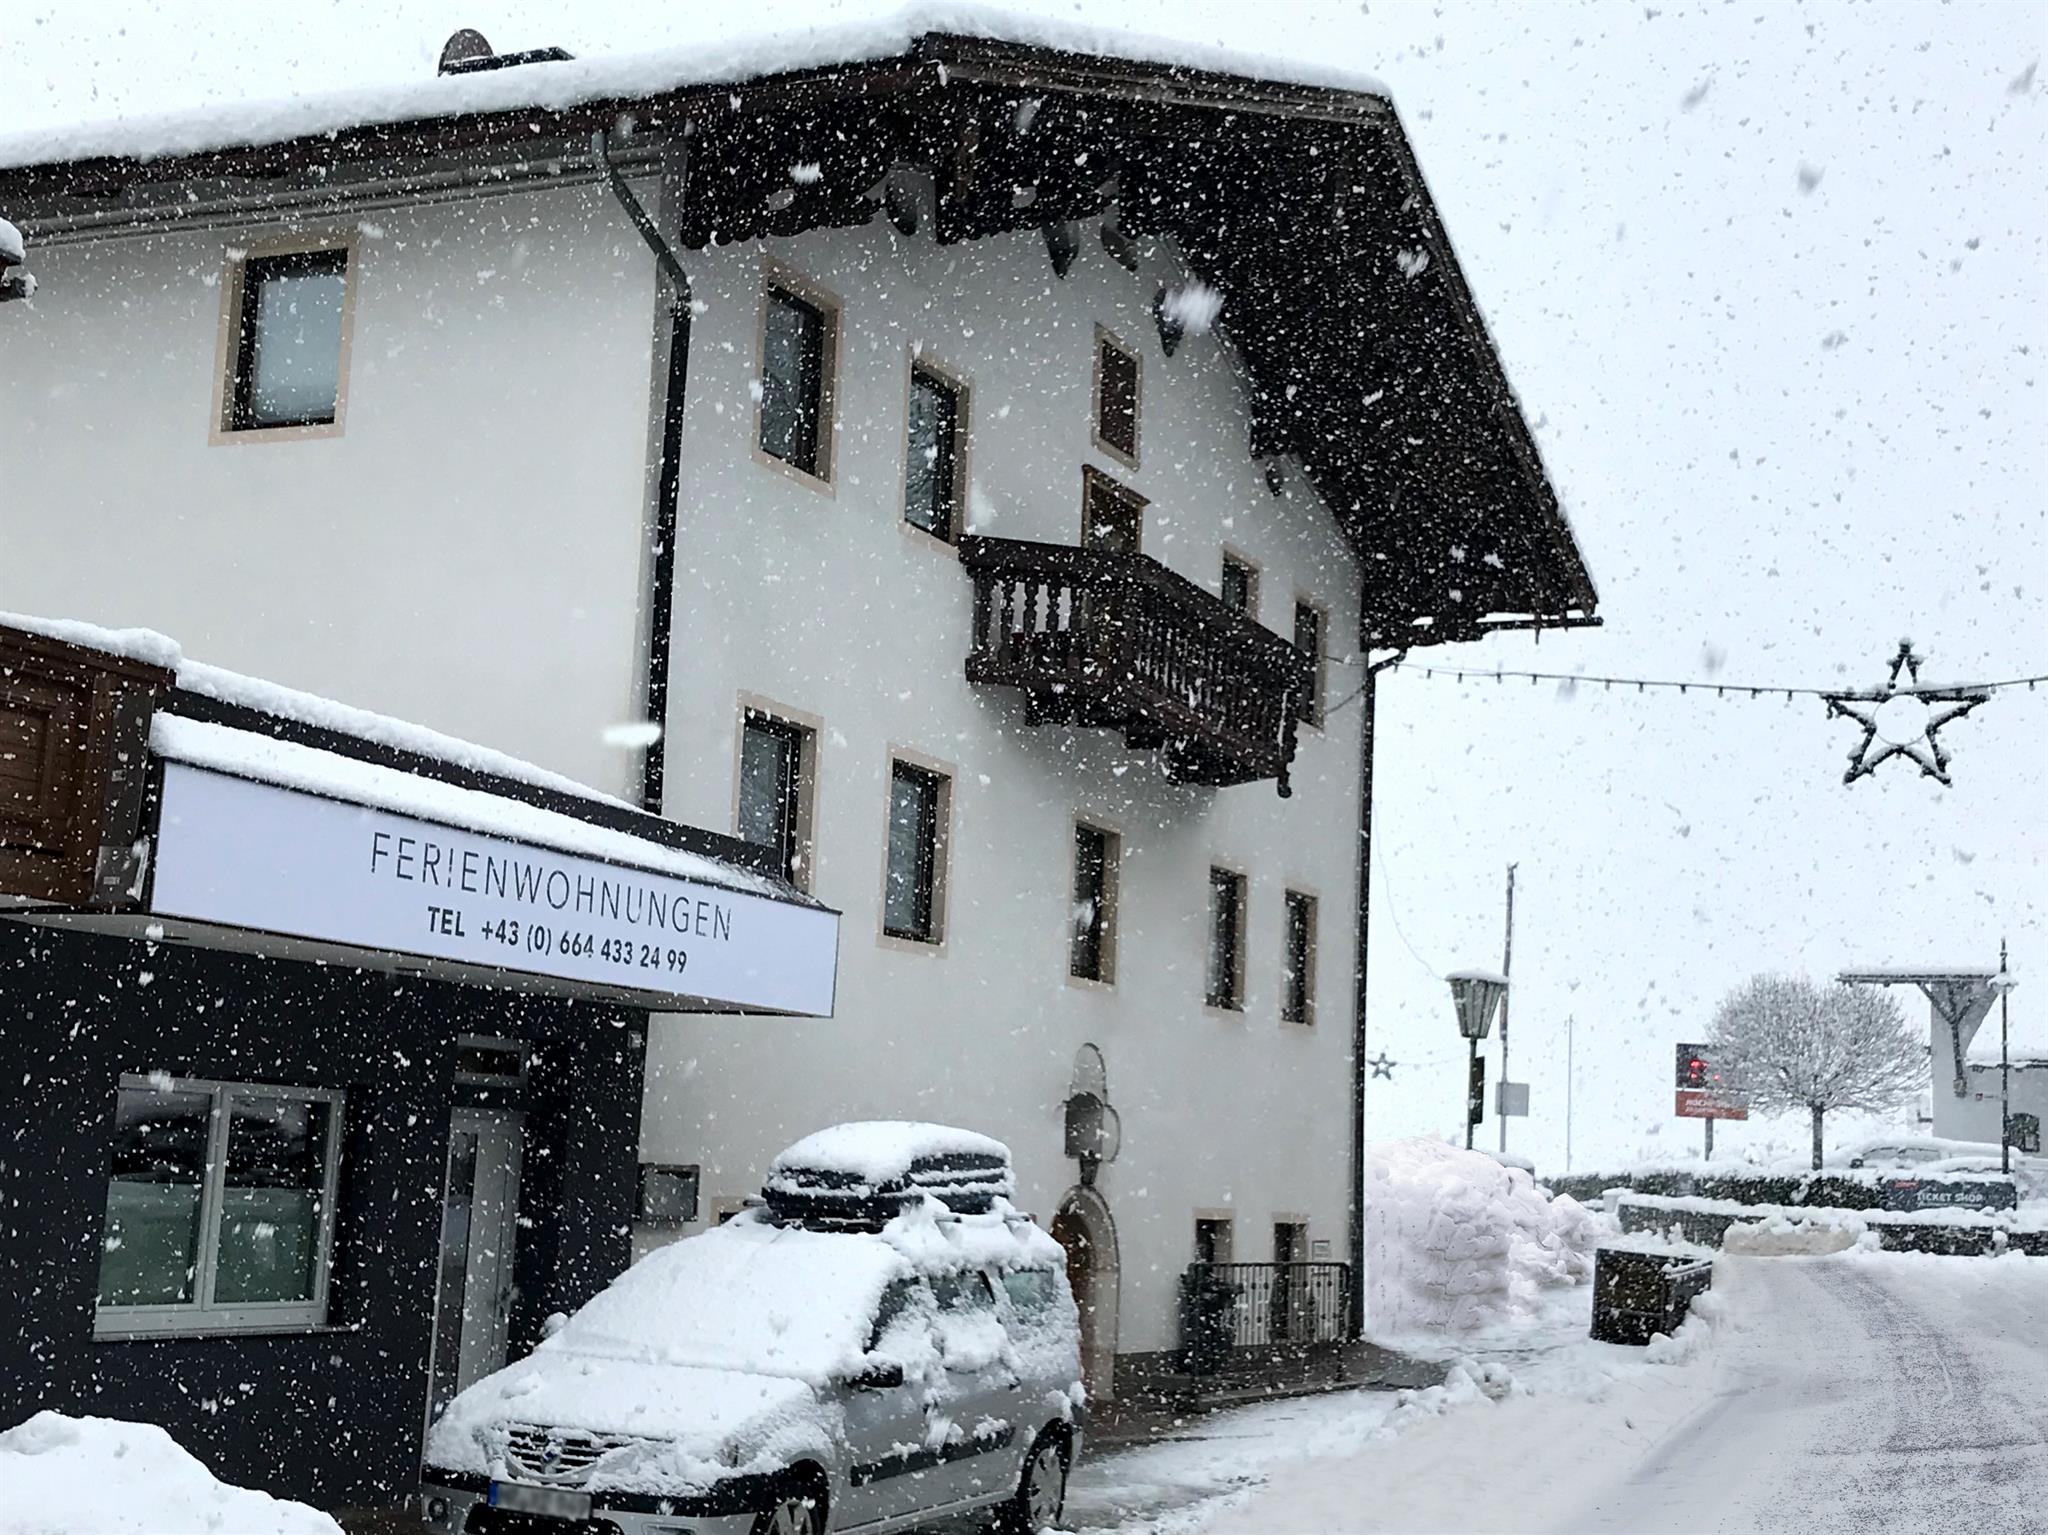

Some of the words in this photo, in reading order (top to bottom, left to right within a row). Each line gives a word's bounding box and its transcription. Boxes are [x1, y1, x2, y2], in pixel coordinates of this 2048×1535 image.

[371, 831, 731, 941] FERIENWOHNUNGEN
[427, 906, 465, 937] TEL
[481, 919, 519, 946] +43
[527, 924, 552, 957] (0)
[560, 930, 594, 958] 664
[600, 938, 633, 966] 433
[640, 944, 660, 970] 24
[667, 949, 687, 974] 99
[1916, 1192, 1952, 1202] TICKET
[1954, 1192, 1983, 1203] SHOP
